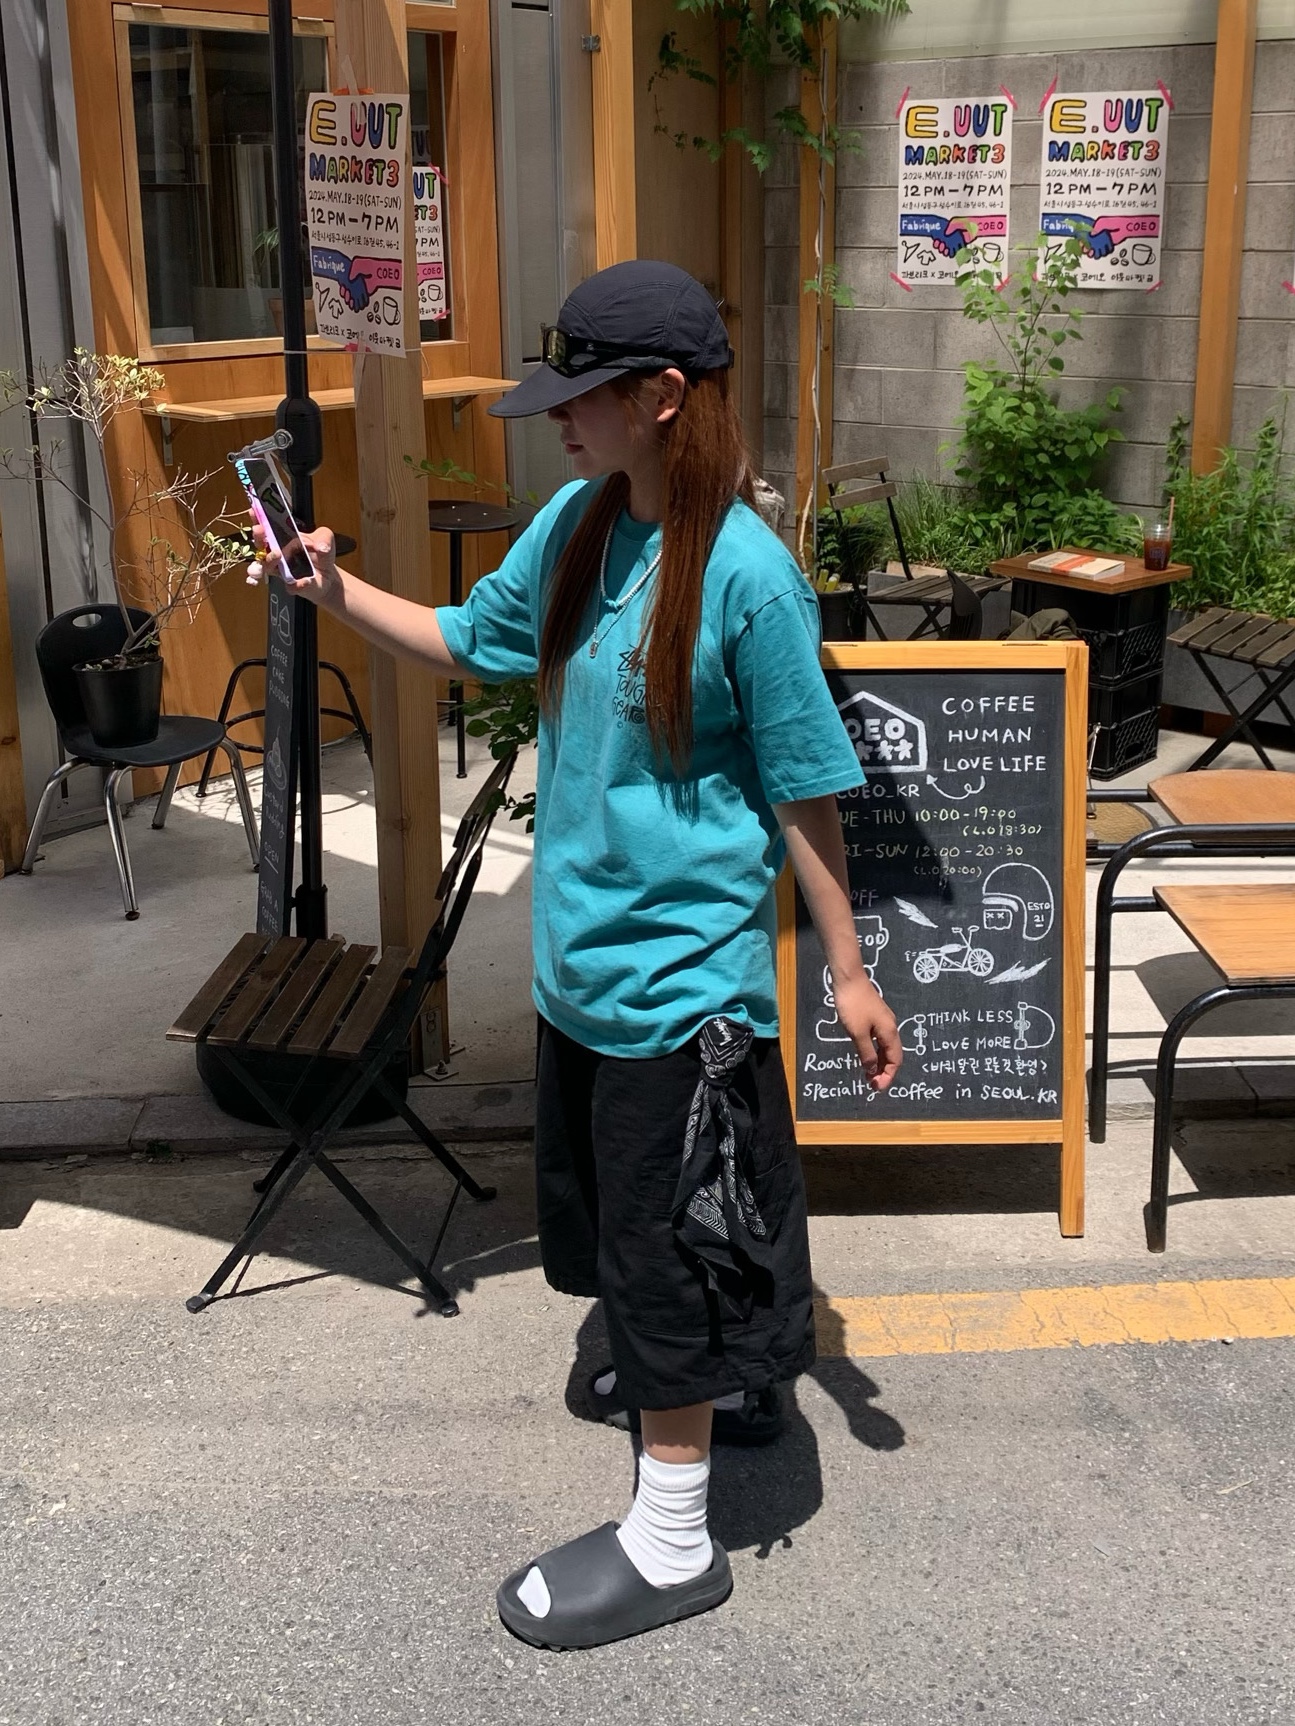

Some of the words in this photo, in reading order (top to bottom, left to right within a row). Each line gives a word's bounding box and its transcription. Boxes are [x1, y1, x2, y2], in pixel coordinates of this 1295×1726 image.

[309, 99, 402, 150] E.UUT
[905, 103, 1007, 139] E.UUT
[1050, 98, 1163, 134] E.UUT
[904, 144, 1006, 166] MARKET3
[1048, 139, 1160, 163] MARKET3
[309, 152, 400, 187] MARKET3
[902, 219, 941, 233] Fabrique
[1043, 219, 1075, 232] Fabriq
[1126, 222, 1156, 232] COEO
[313, 255, 345, 274] Fabrique
[376, 267, 400, 280] COEO
[422, 266, 442, 275] COEO
[942, 695, 1035, 716] COFFEE
[844, 717, 906, 741] OEO
[948, 727, 1032, 743] HUMAN
[943, 756, 993, 772] LOVE
[1000, 755, 1047, 772] LIFE
[1033, 914, 1044, 923] 21
[927, 1008, 971, 1026] THINK
[977, 1009, 1013, 1023] LESS
[932, 1037, 970, 1051] LOVE
[976, 1036, 1011, 1051] MORE
[804, 1053, 862, 1072] Roasti
[888, 1082, 944, 1101] coffee
[956, 1083, 971, 1099] in
